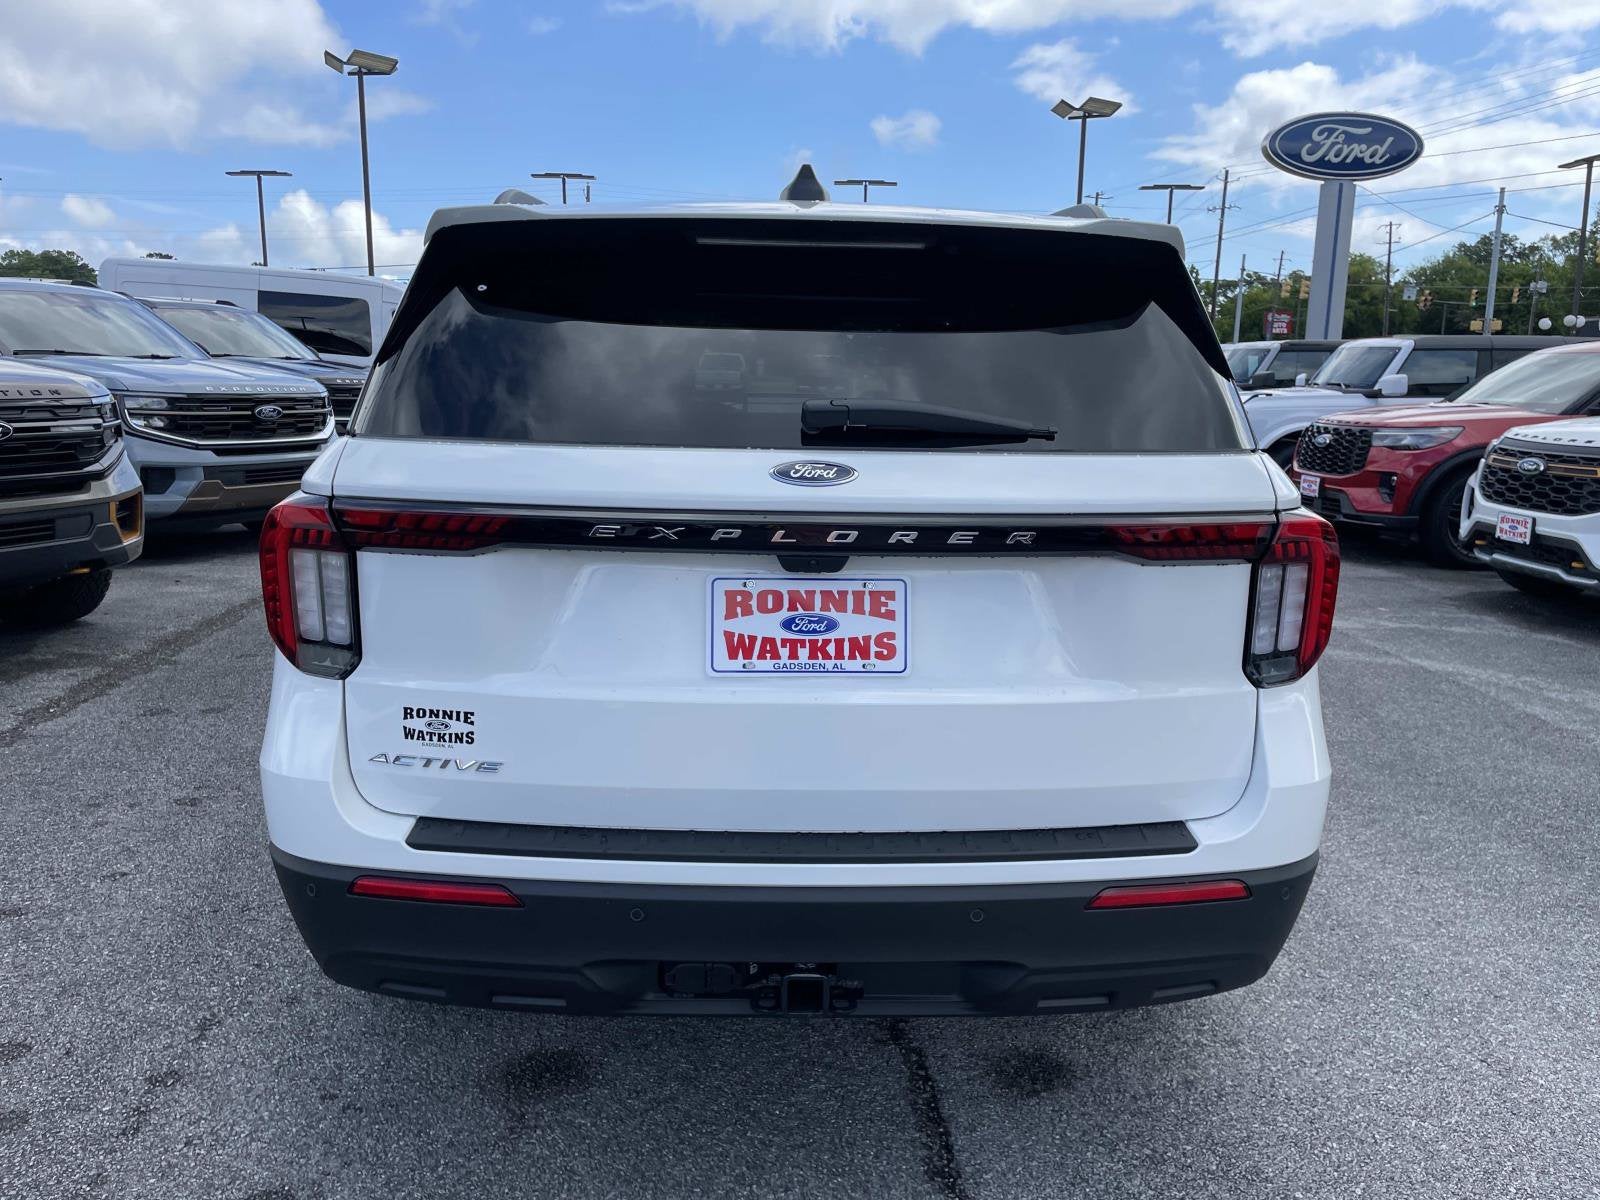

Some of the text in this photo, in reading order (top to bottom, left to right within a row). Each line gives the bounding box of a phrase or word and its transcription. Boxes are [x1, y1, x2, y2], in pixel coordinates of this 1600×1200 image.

[1300, 124, 1395, 165] Ford
[205, 385, 307, 393] EXPEDITION
[790, 463, 837, 478] Ford
[1500, 515, 1529, 530] RONNIE
[588, 524, 1037, 545] EXPLORER
[1498, 527, 1528, 540] WATKINS
[724, 589, 897, 622] RONNIE
[791, 616, 828, 632] Ford
[723, 630, 897, 662] WATKINS
[772, 662, 847, 672] GADSDEN, AL
[402, 706, 475, 726] RONNIE
[402, 725, 475, 745] WATKINS
[368, 753, 505, 773] ACTIVE
